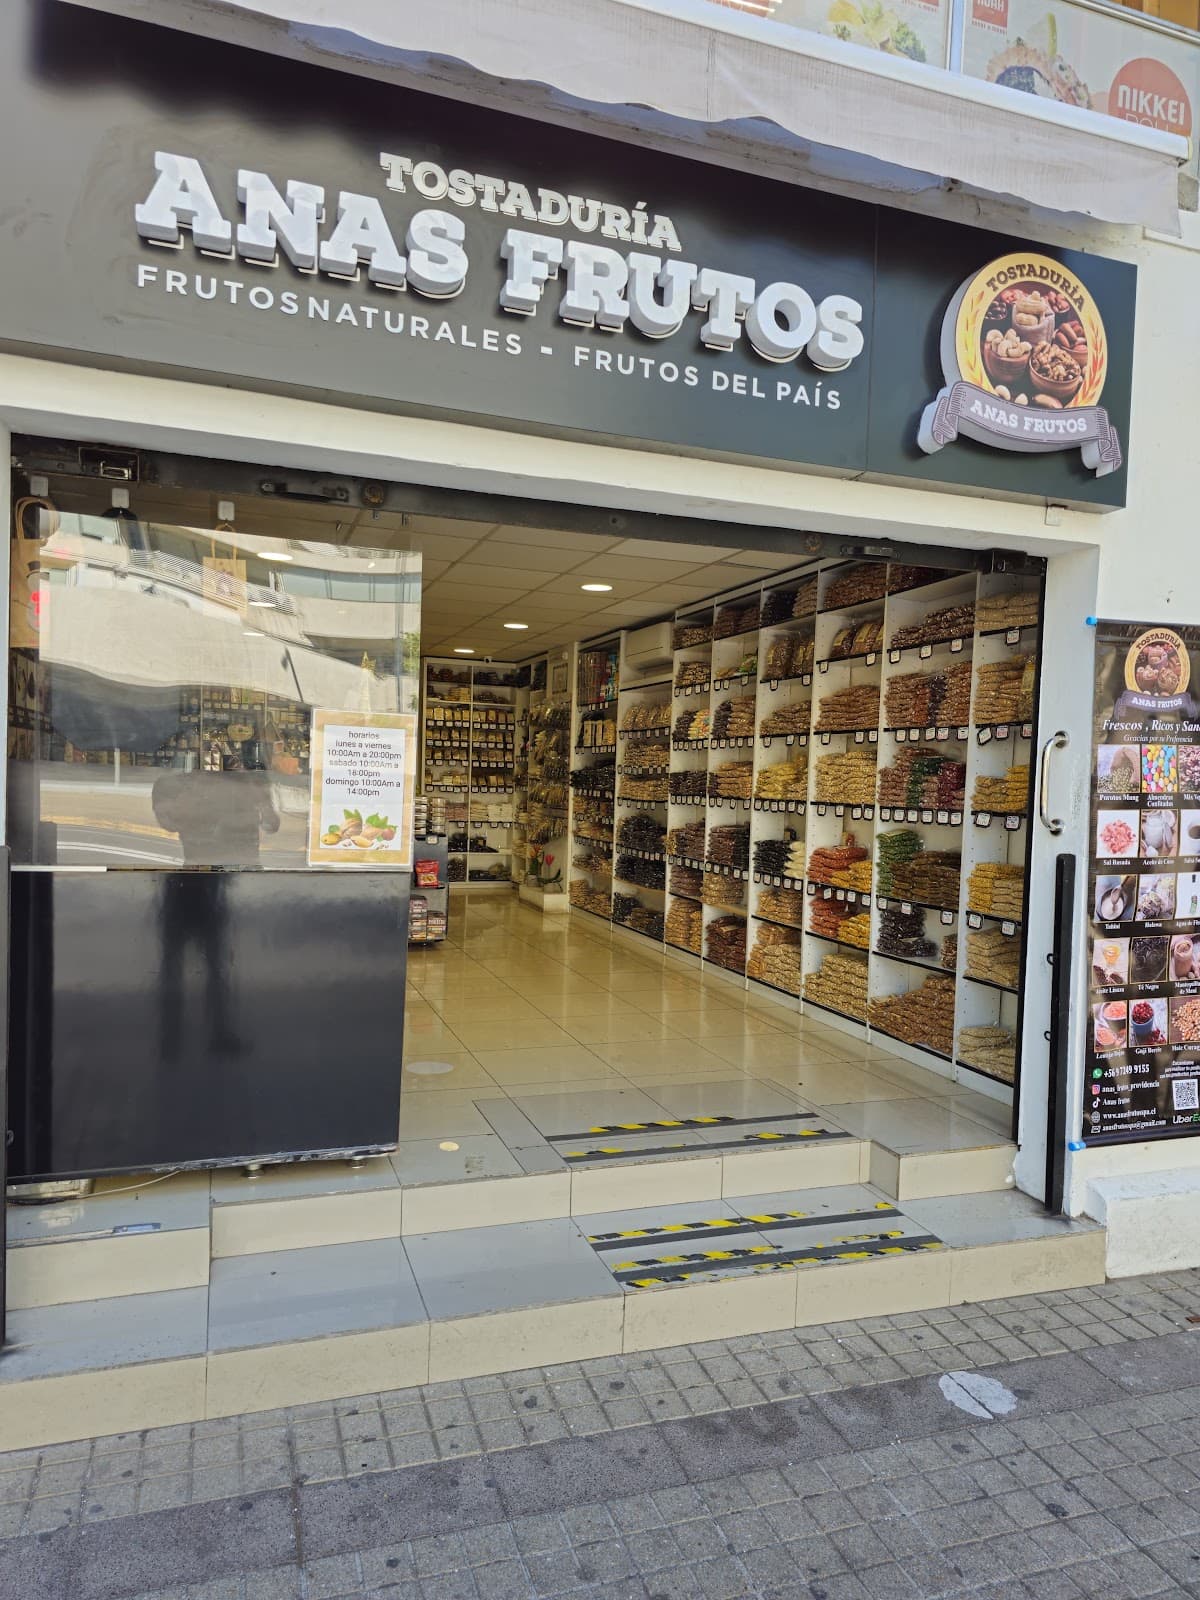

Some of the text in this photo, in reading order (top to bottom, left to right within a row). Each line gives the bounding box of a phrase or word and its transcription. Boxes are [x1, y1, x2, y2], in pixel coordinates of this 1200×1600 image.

[379, 151, 682, 253] TOSTADURÍA
[135, 150, 865, 373] ANAS FRUTOS
[985, 263, 1085, 313] TOSTADURÍA
[574, 346, 699, 387] FRUTOS
[712, 370, 766, 399] DEL
[777, 381, 842, 411] PAÍS
[969, 399, 1087, 433] ANAS FRUTOS
[348, 731, 380, 740] horarios
[1102, 719, 1144, 731] Frescos
[1151, 719, 1174, 731] Ricos
[1174, 723, 1181, 734] y
[1181, 720, 1200, 732] San
[335, 740, 356, 748] lunes
[365, 742, 392, 750] viernes
[325, 777, 359, 787] domingo
[1133, 1063, 1150, 1074] 9155
